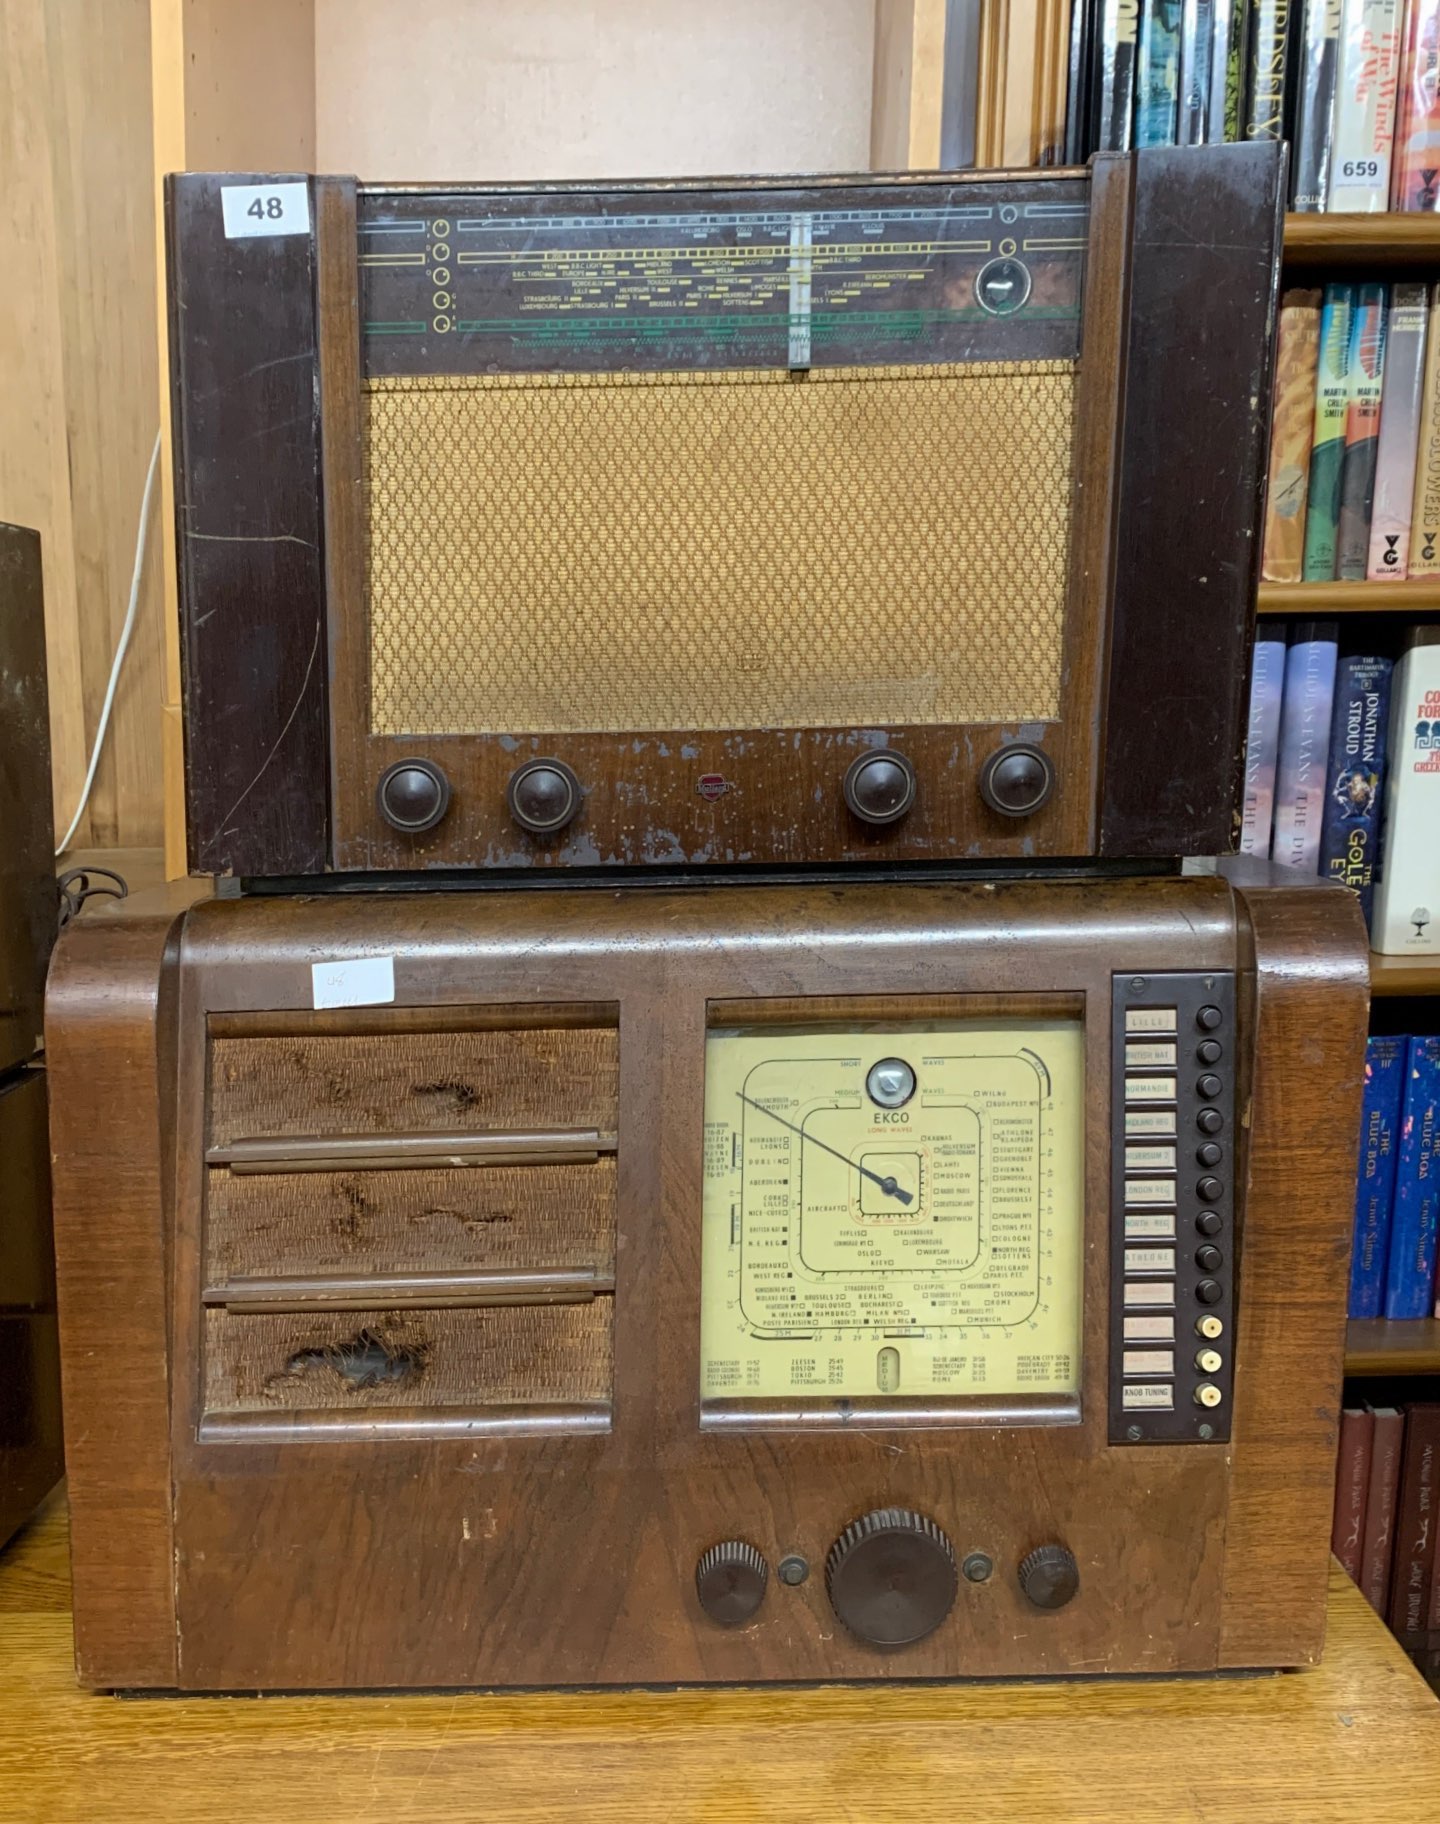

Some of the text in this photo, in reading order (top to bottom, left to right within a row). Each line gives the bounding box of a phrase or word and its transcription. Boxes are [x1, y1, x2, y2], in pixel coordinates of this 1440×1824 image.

[1381, 28, 1400, 72] The
[1374, 74, 1396, 153] Winds
[1343, 161, 1378, 177] 659
[247, 197, 284, 220] 48
[1249, 642, 1268, 725] NICHOLAS
[1294, 642, 1321, 828] NICHOLAS EVANS THE
[1345, 701, 1362, 756] STROUD
[1363, 692, 1380, 763] JONATHAN
[1247, 730, 1264, 783] EVANS
[1243, 794, 1258, 829] THE
[1363, 863, 1373, 887] THE
[1126, 1084, 1169, 1092] NORMANDIE
[873, 1112, 910, 1124] EKCO
[1365, 1111, 1381, 1179] BLUE BOA
[1380, 1129, 1391, 1156] THE
[1418, 1111, 1434, 1180] BLUE BOA
[1363, 1195, 1380, 1272] Jenny Nimmo
[1415, 1199, 1433, 1273] Jenny Nimmo
[1125, 1253, 1169, 1261] ATHLONE
[1000, 1290, 1035, 1298] STOCKHOLM
[1124, 1387, 1168, 1397] KNOB TUNING
